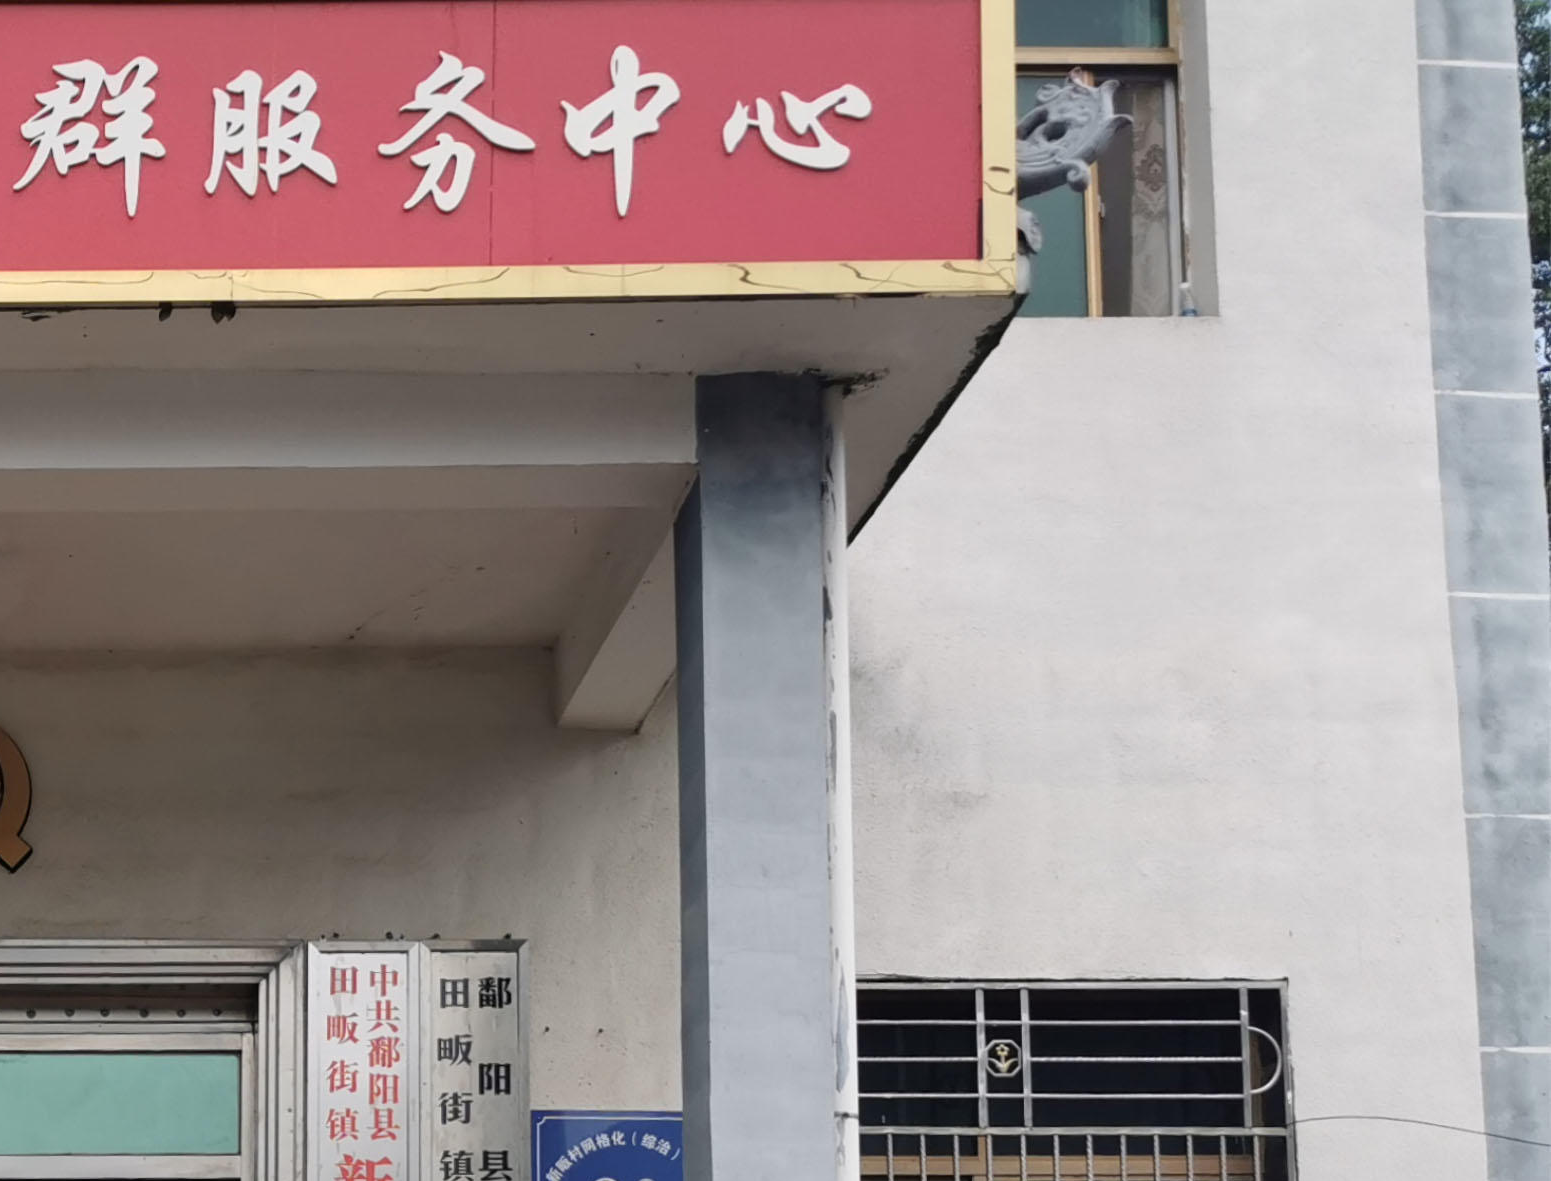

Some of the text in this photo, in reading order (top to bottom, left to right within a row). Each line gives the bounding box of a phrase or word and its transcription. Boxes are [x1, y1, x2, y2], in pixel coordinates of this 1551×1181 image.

[326, 965, 360, 1142] 田畈街镇
[366, 963, 401, 1142] 中共鄱阳县
